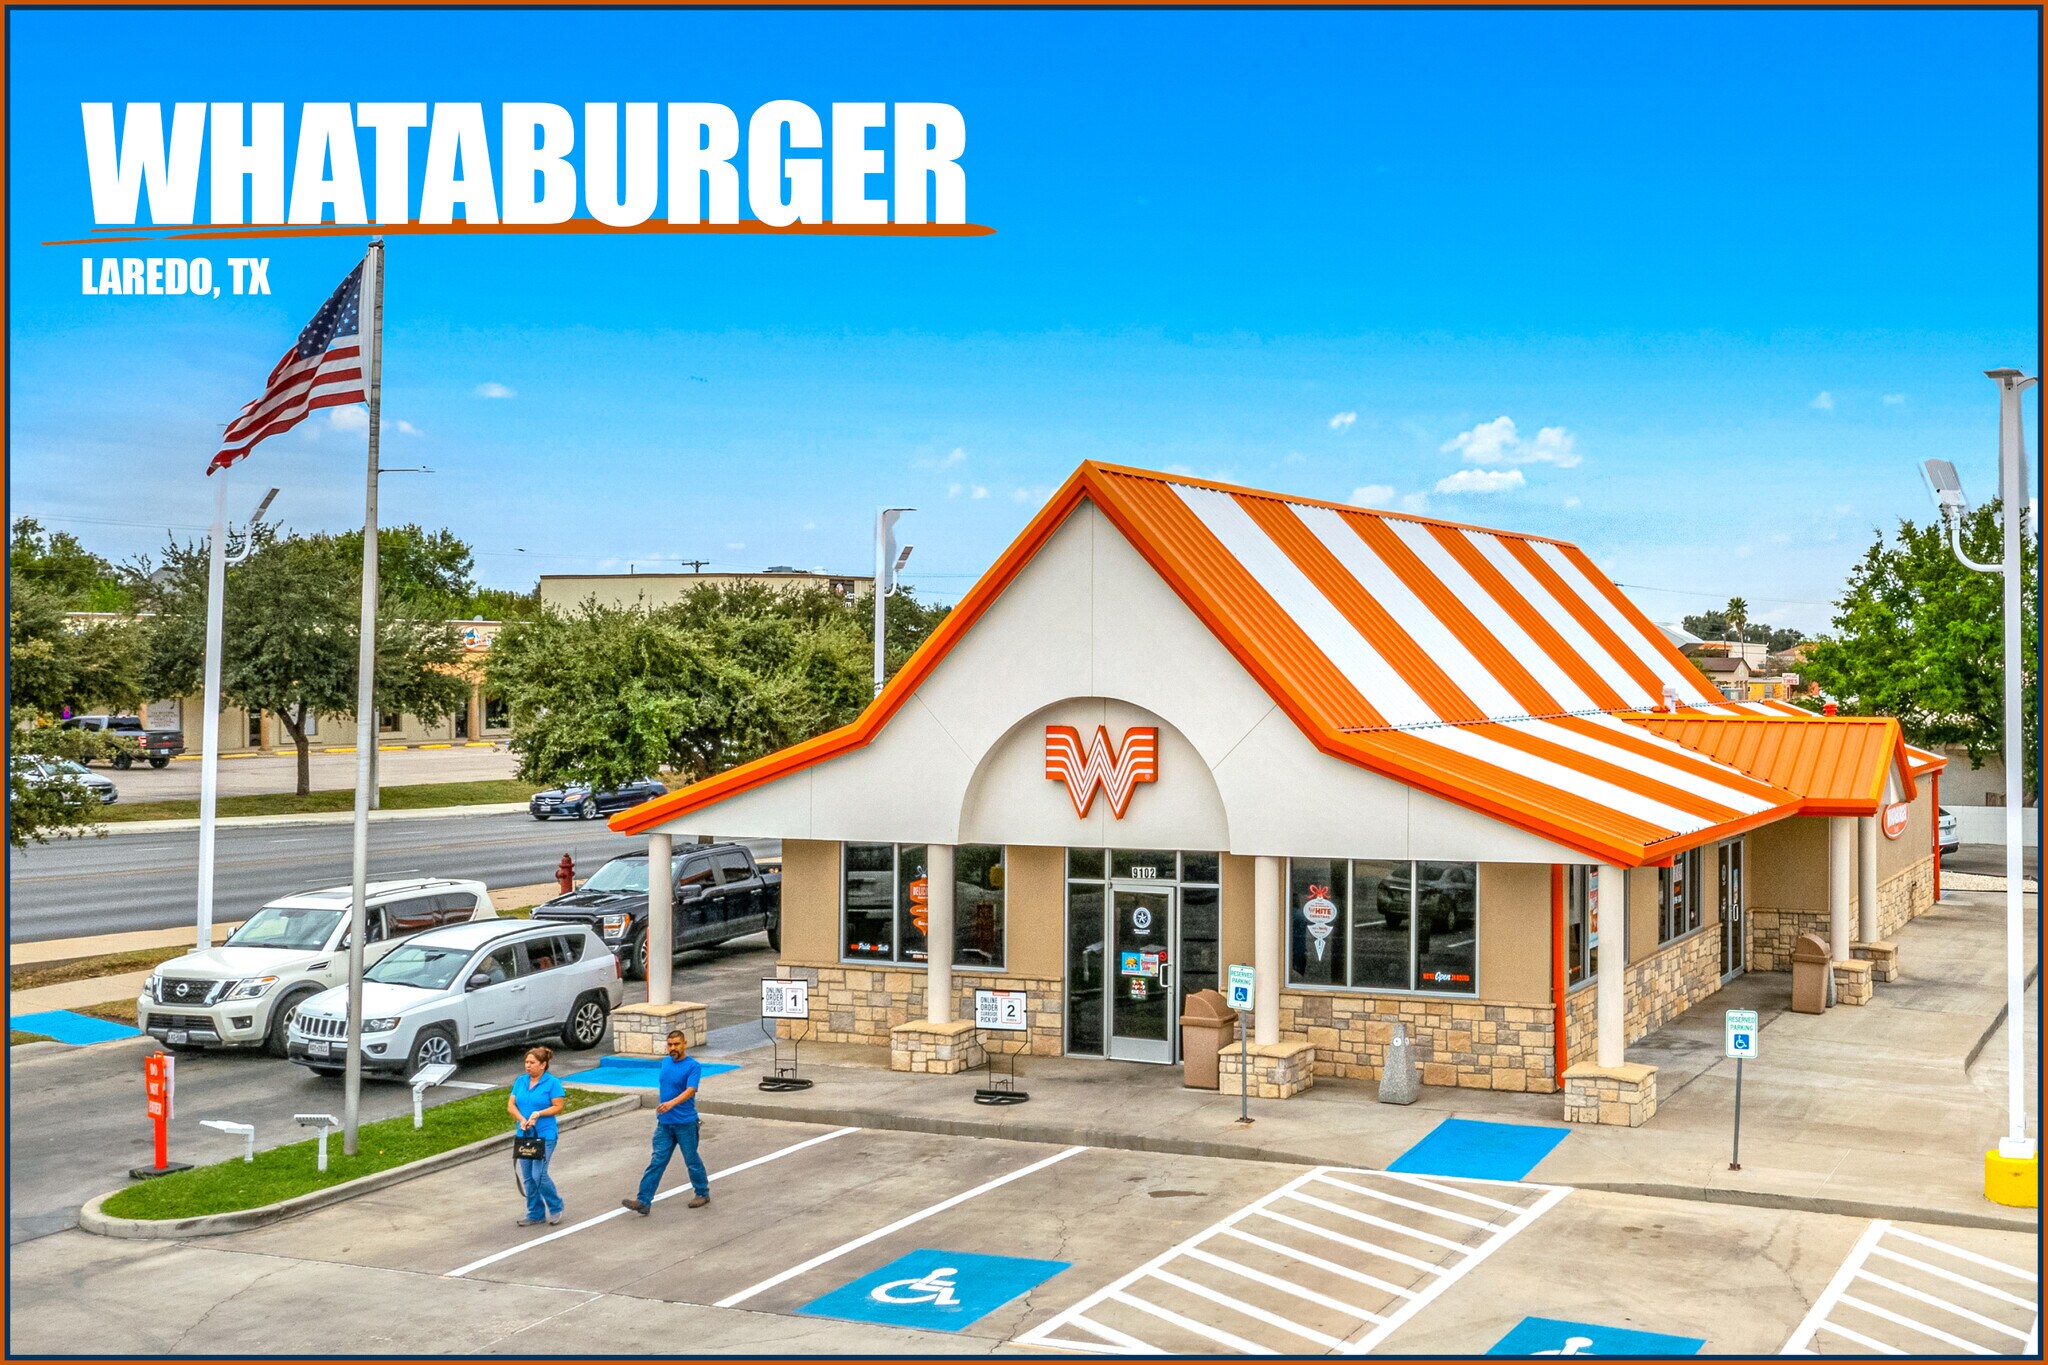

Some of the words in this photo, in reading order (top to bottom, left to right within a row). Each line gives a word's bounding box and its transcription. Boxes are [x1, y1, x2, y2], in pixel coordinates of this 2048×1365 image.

[1132, 867, 1155, 878] 9102
[1231, 970, 1255, 979] RESERVED
[1232, 977, 1252, 986] PARKING
[791, 994, 798, 1007] 1
[1006, 1004, 1016, 1018] 2
[1728, 1016, 1755, 1024] RESERVED
[1730, 1024, 1753, 1032] PARKING
[150, 1063, 158, 1076] DO
